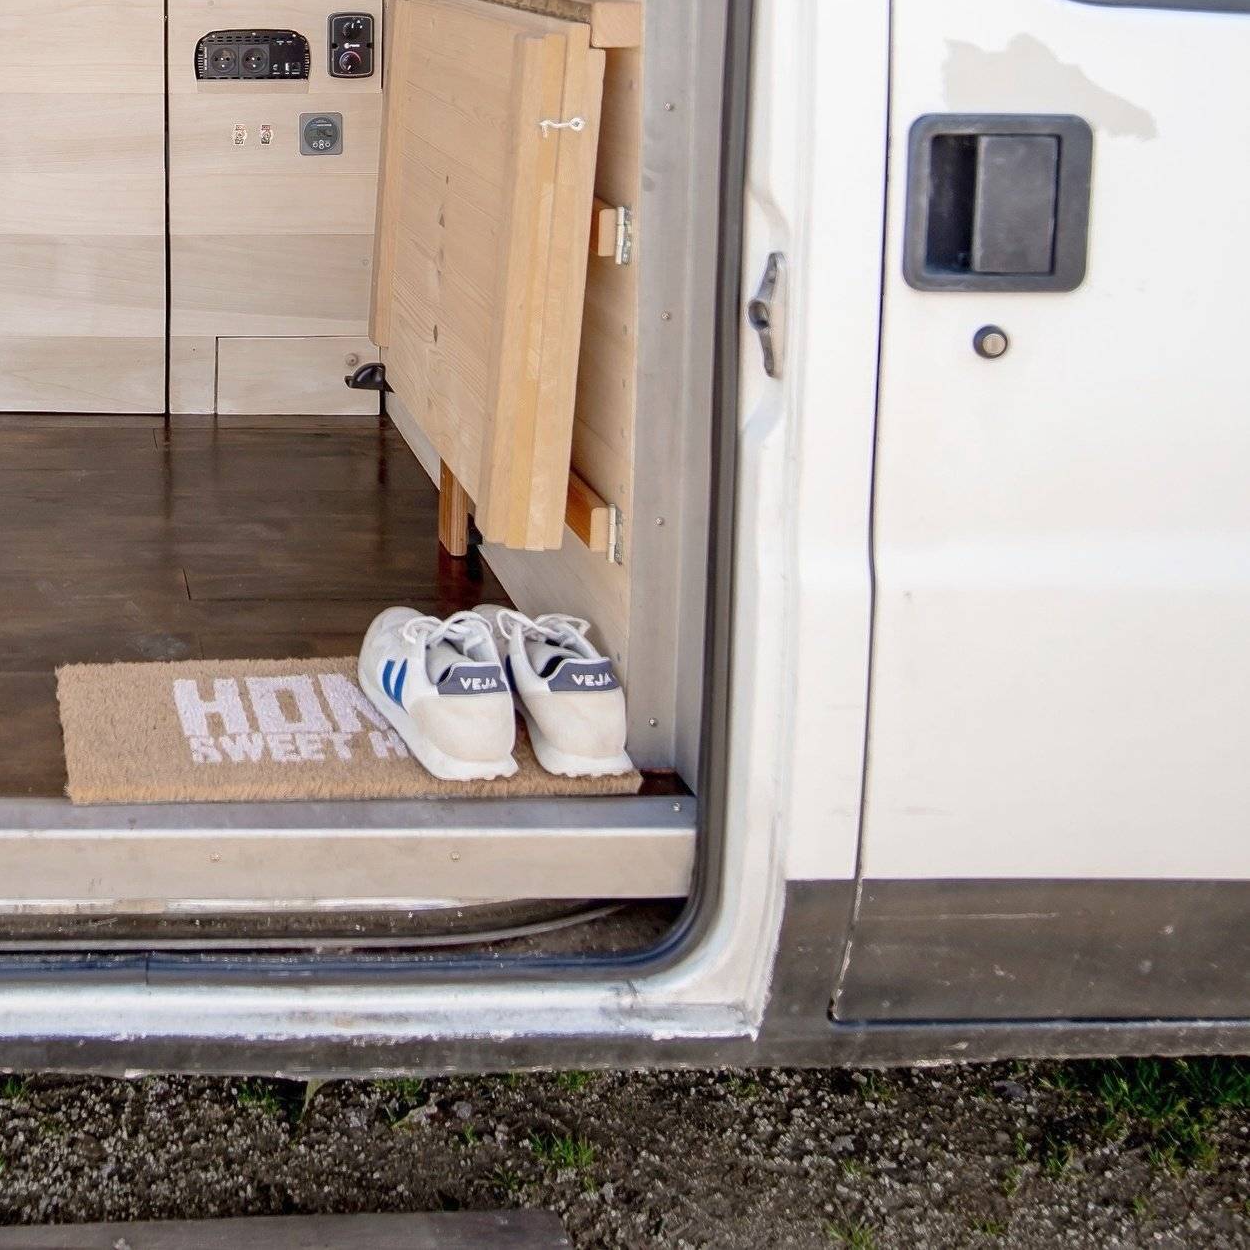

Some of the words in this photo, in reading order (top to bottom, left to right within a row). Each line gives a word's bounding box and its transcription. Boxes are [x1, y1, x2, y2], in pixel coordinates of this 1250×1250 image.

[459, 676, 497, 691] VEJA
[572, 672, 612, 687] VEJA
[190, 731, 353, 764] SWEET
